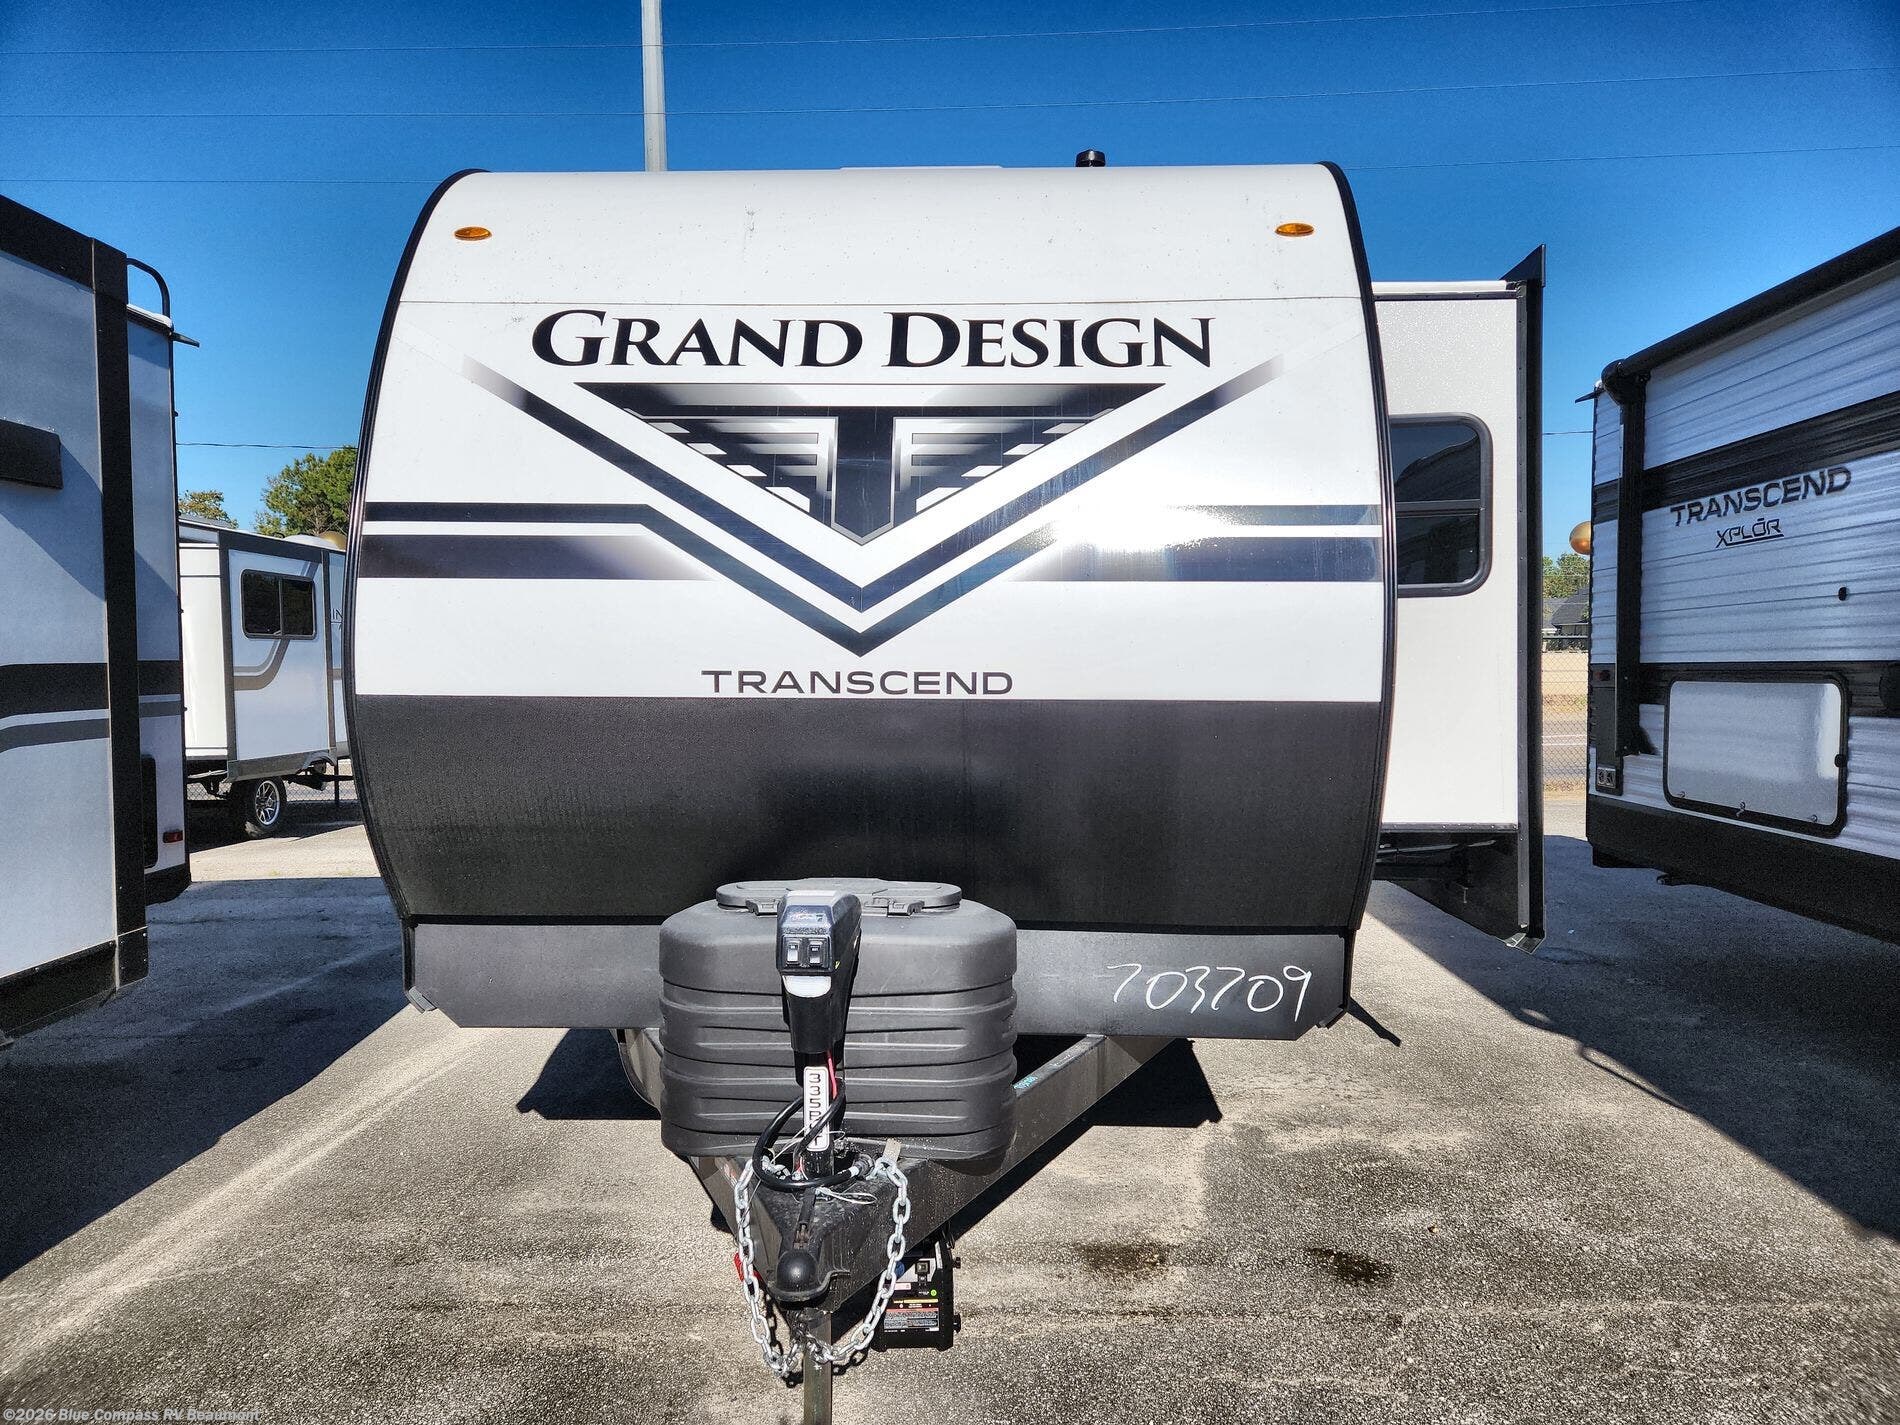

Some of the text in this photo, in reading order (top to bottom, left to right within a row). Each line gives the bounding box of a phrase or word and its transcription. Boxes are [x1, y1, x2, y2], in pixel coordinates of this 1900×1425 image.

[532, 309, 1212, 368] GRAND DESIGN
[1670, 466, 1852, 527] TRANSCEND
[701, 669, 1014, 695] TRANSCEND
[1107, 963, 1312, 1022] 703709
